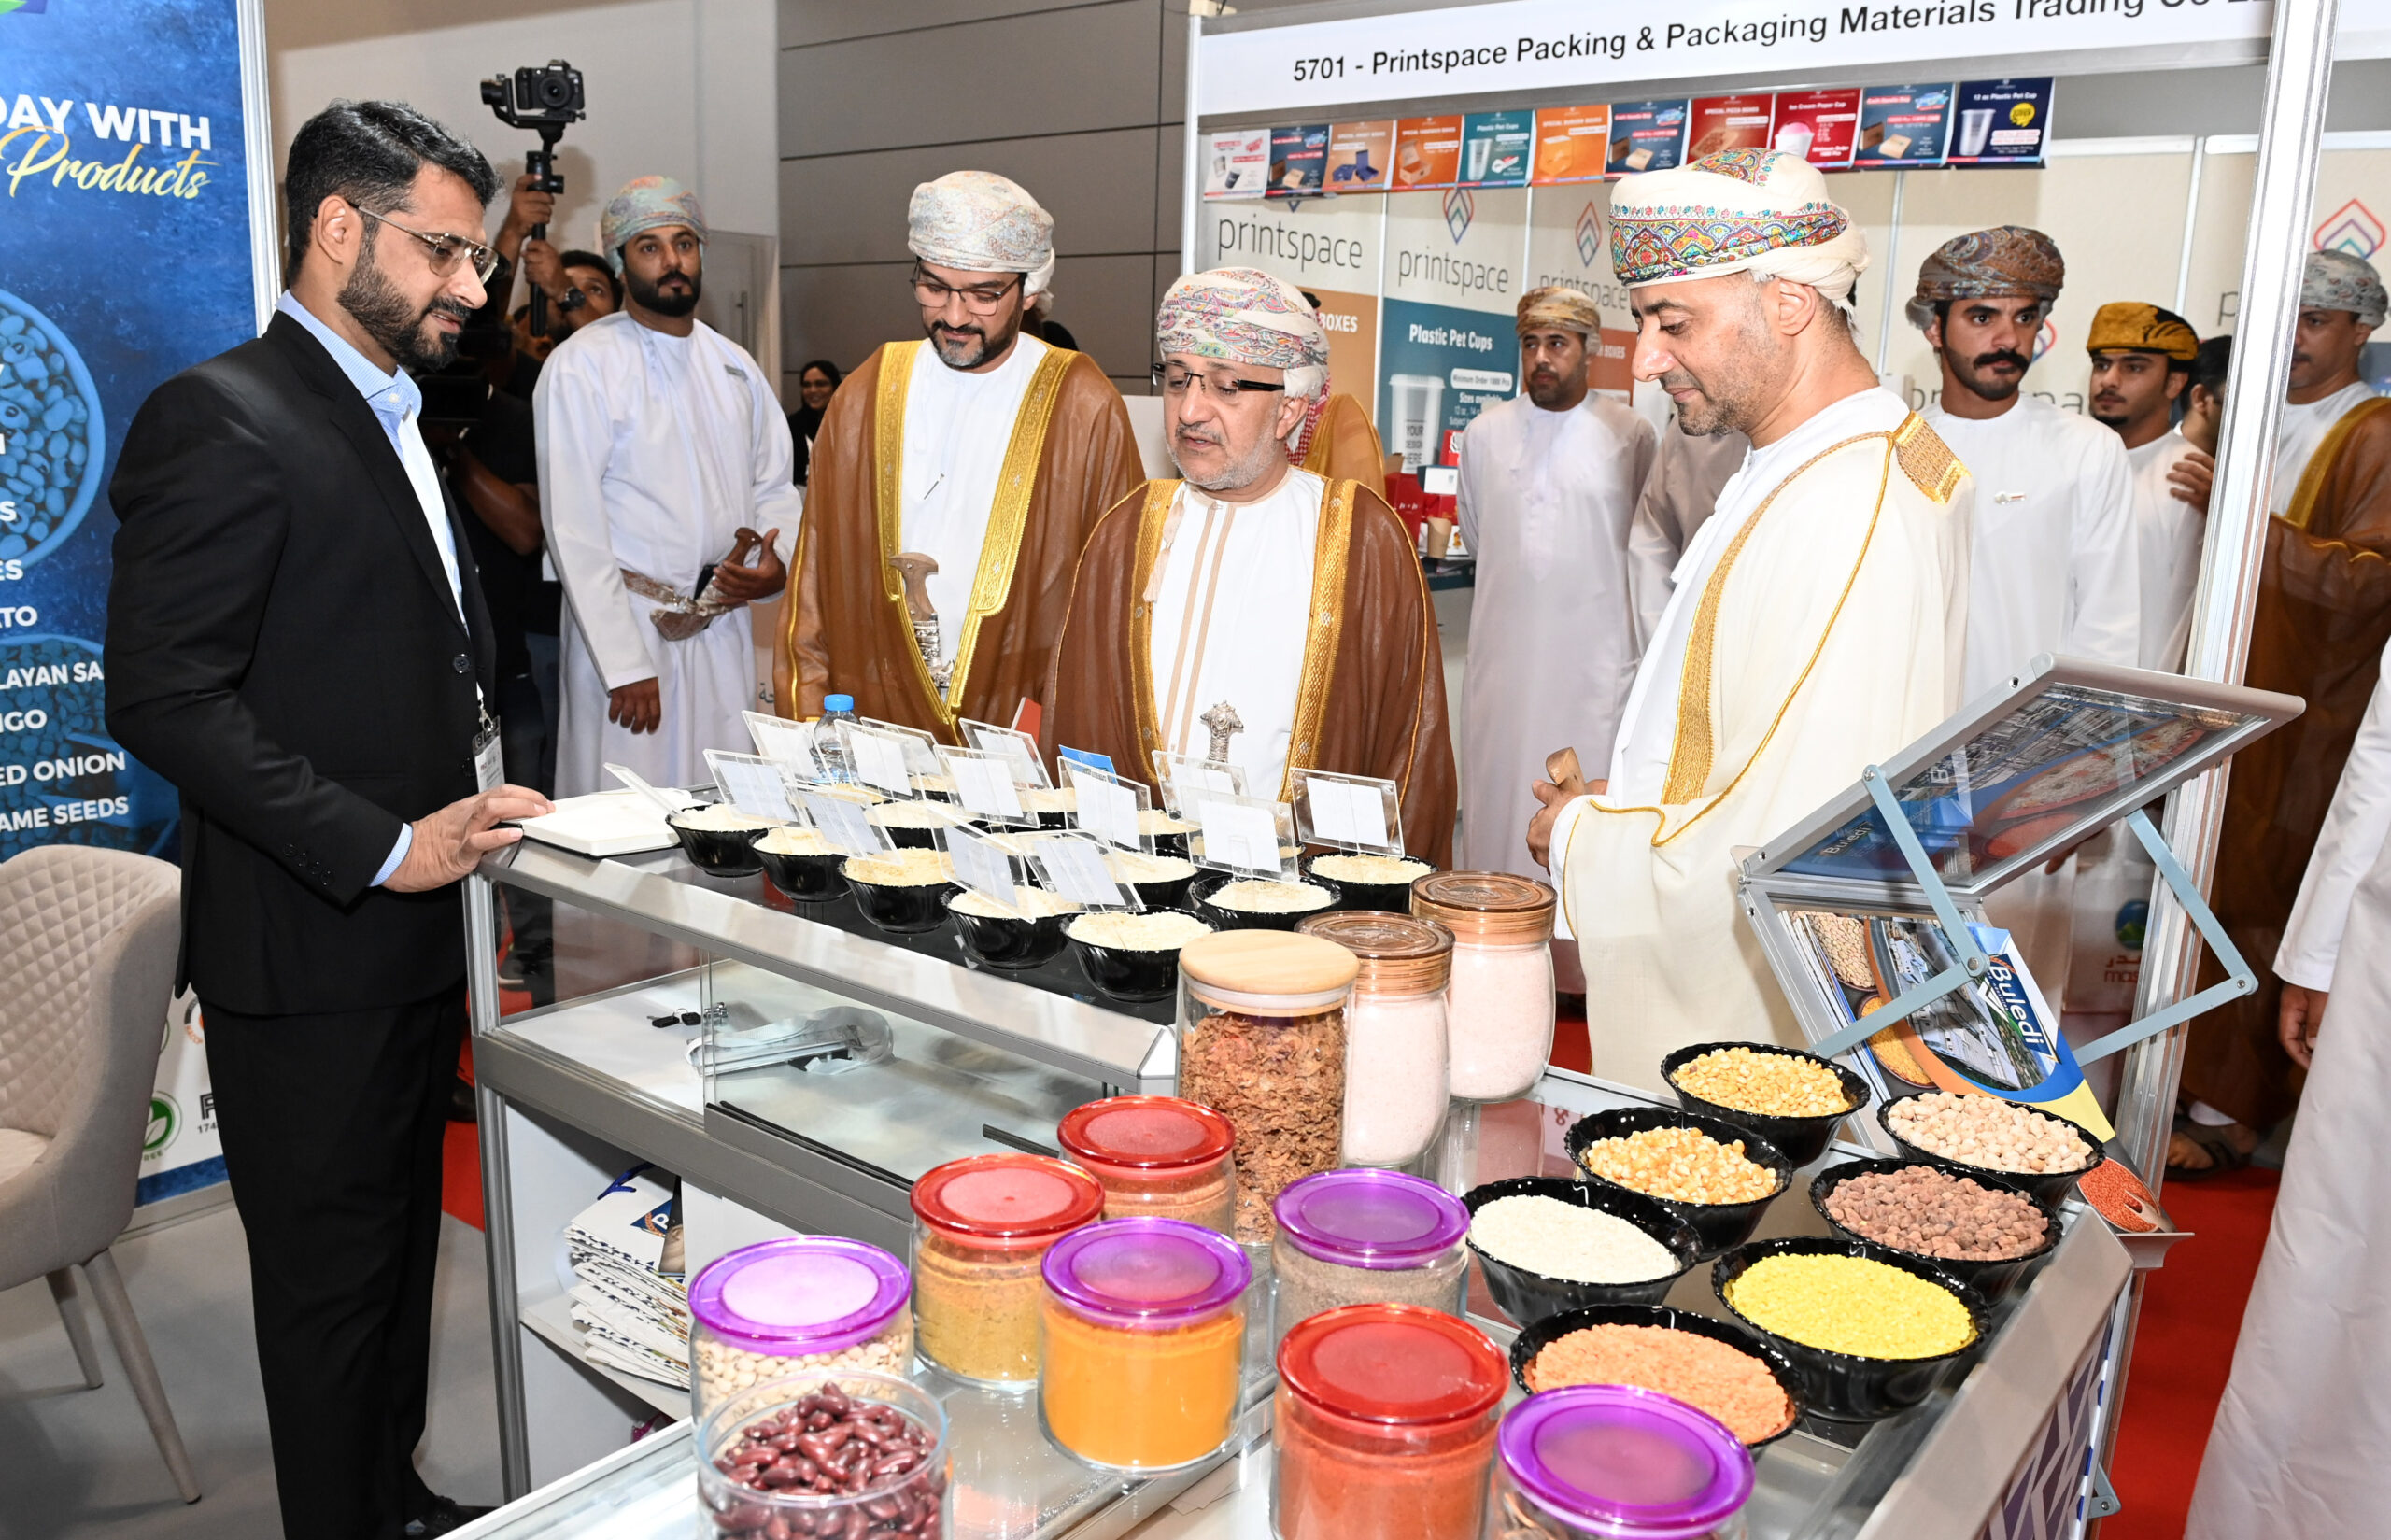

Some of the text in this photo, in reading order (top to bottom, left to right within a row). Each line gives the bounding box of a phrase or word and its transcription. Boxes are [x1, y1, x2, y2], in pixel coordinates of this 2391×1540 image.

[1294, 56, 1345, 81] 5701
[1373, 46, 1507, 74] Printspace
[1517, 33, 1626, 61] Packing
[1636, 26, 1655, 50] &
[1667, 14, 1827, 47] Packaging
[1840, 0, 1996, 34] Materials
[85, 102, 211, 150] WITH
[0, 125, 221, 199] Products
[1218, 216, 1363, 271] printspace
[1398, 247, 1509, 296] printspace
[1409, 324, 1493, 352] Plastic Pet Cups
[0, 606, 38, 629] TO
[73, 661, 104, 683] SA
[0, 709, 47, 733] GO
[33, 752, 125, 781] ONION
[53, 796, 129, 825] SEEDS
[1989, 966, 2044, 1044] Buledi
[143, 1150, 163, 1161] REE
